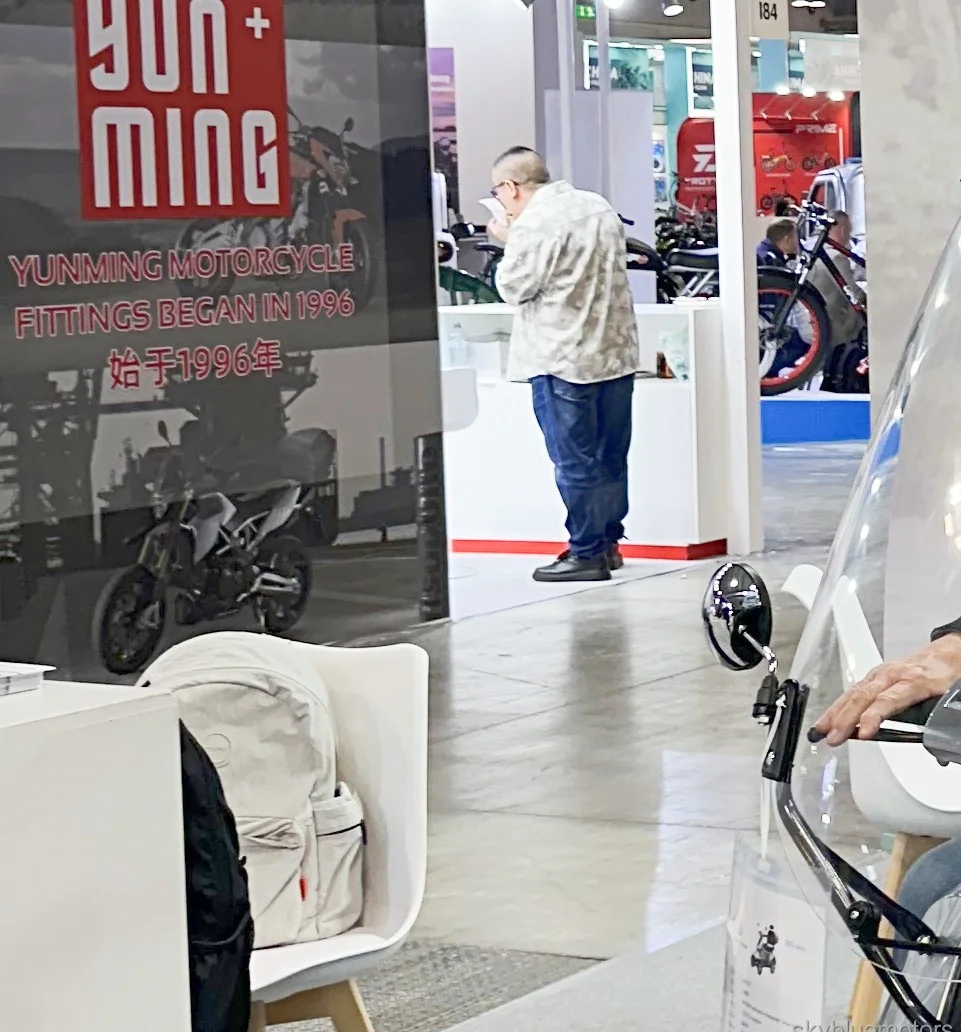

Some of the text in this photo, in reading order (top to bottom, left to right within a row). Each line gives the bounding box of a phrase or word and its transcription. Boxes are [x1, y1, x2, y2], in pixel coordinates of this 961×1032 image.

[759, 2, 777, 20] 184
[91, 106, 281, 208] MING
[8, 243, 354, 287] YUNMING MOTORCYCLE
[15, 289, 354, 339] FITTINGS BEGAN IN 1996
[109, 337, 283, 390] 始于1996年
